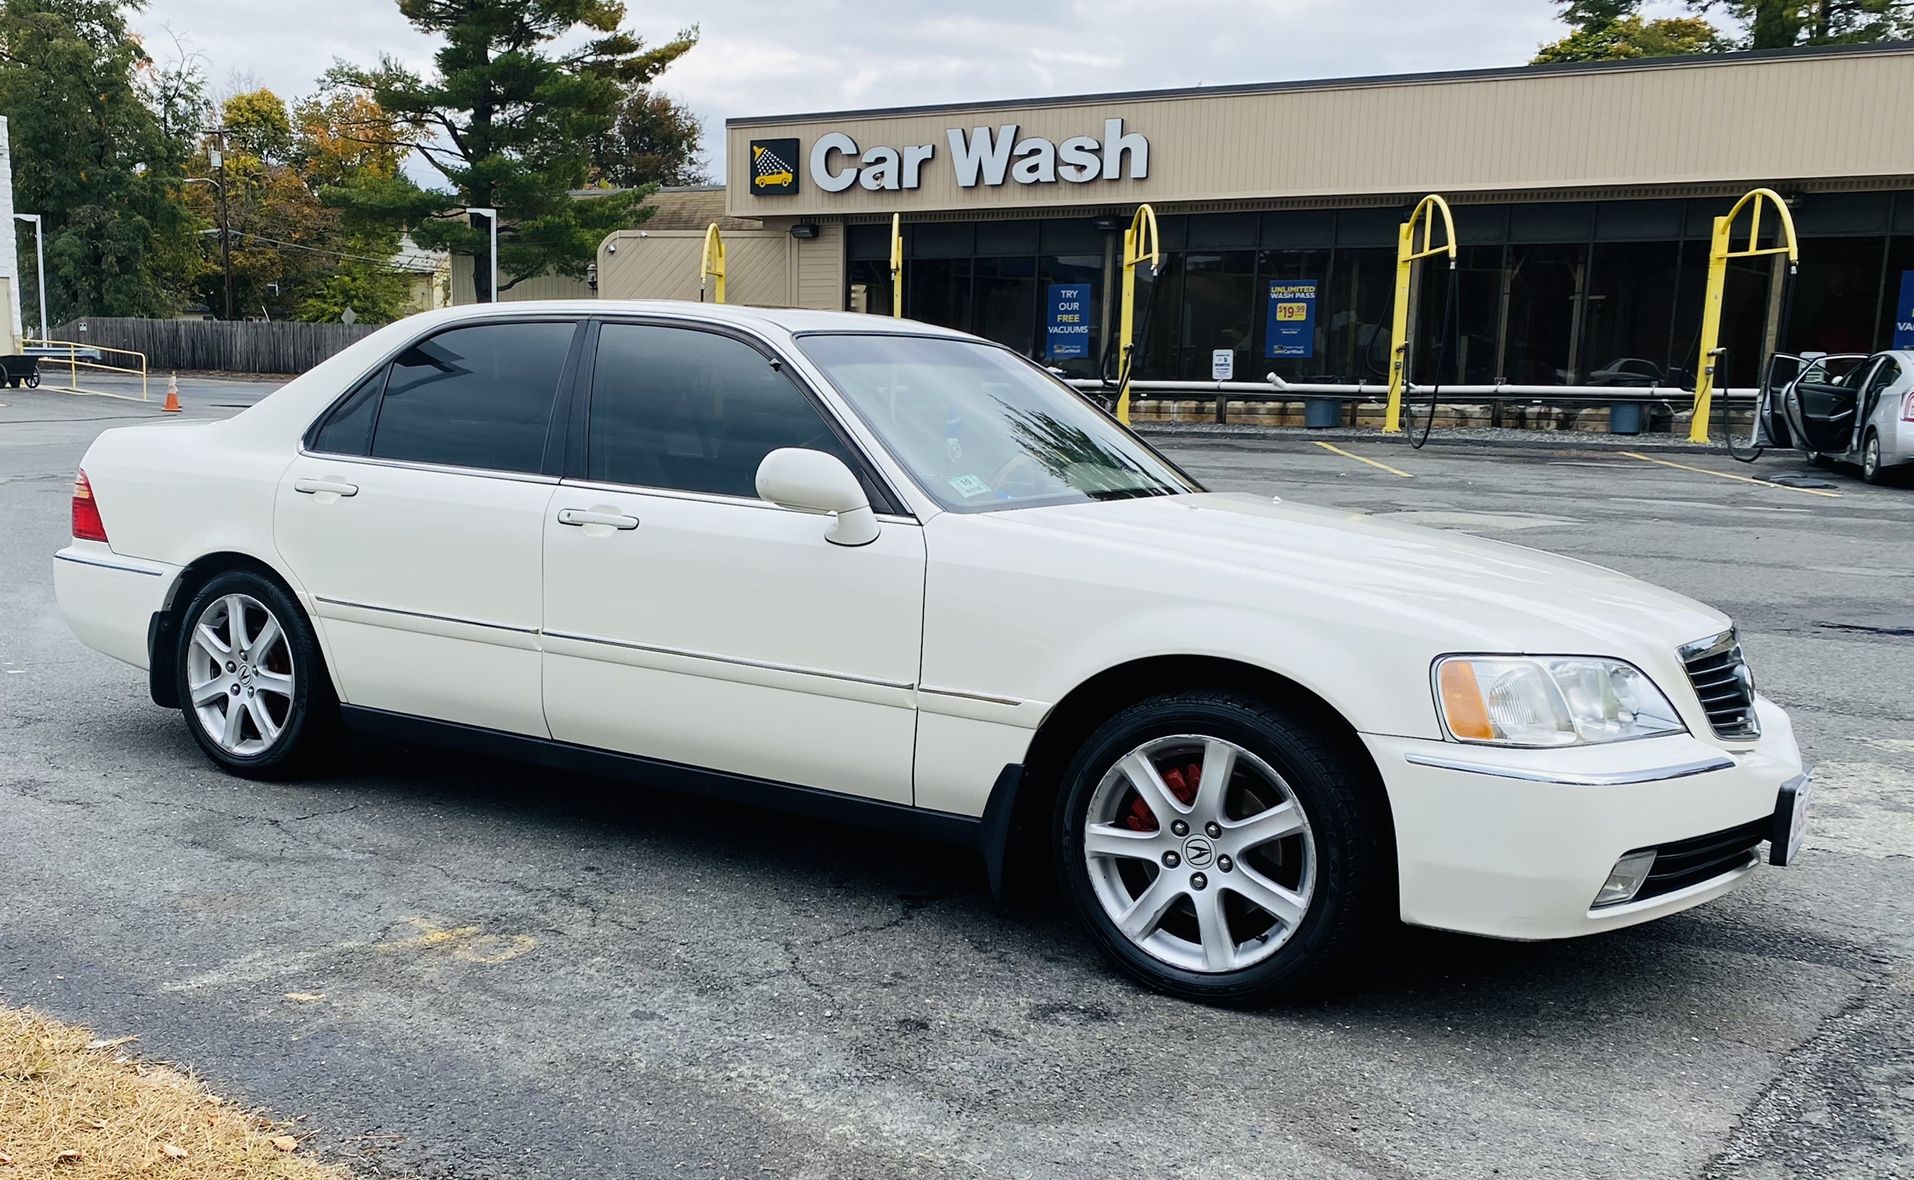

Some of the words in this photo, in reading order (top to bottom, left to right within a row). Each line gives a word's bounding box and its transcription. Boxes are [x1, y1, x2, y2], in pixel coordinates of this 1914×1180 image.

[810, 132, 935, 193] Car
[946, 118, 1149, 187] Wash
[1060, 290, 1079, 299] TRY
[1058, 302, 1080, 311] OUR
[1057, 314, 1080, 323] FREE
[1048, 325, 1089, 334] VACUUMS
